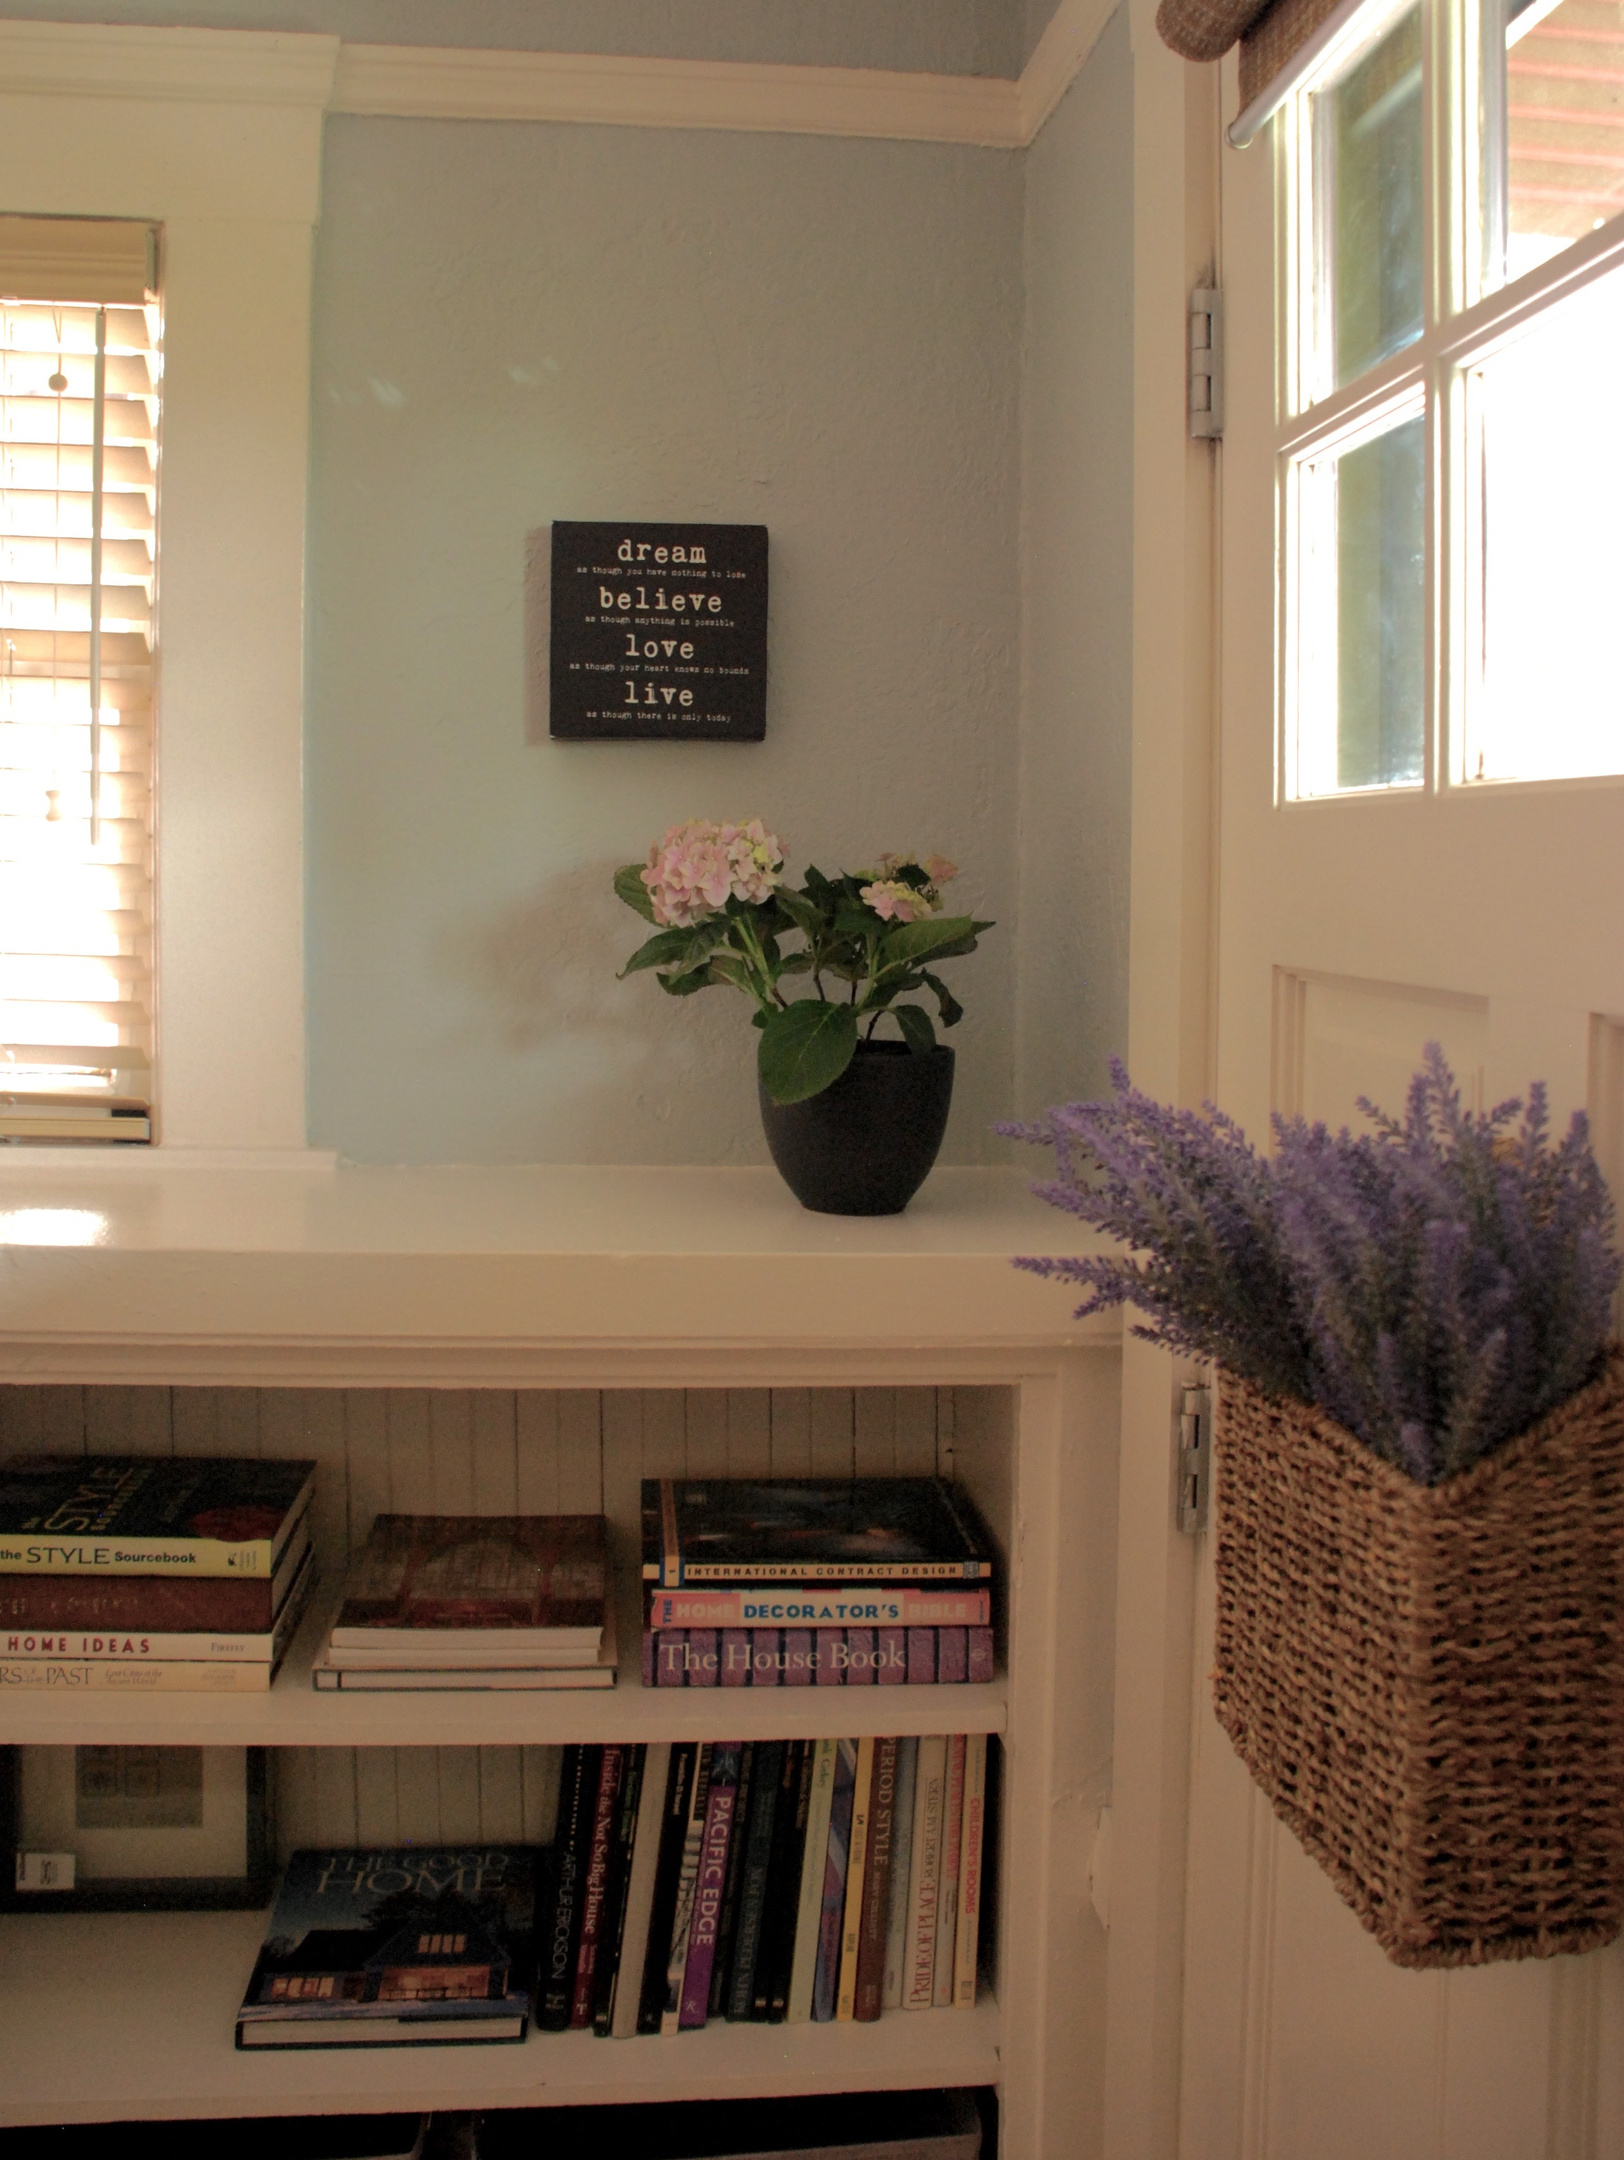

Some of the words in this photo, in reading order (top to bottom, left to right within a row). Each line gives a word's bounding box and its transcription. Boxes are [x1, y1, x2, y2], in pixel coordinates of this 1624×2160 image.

[617, 539, 707, 563] dream
[593, 566, 622, 575] though
[671, 569, 707, 578] nothing
[712, 570, 721, 578] to
[726, 571, 746, 579] lose
[599, 586, 722, 613] believe
[601, 615, 630, 624] though
[635, 616, 675, 626] anything
[695, 619, 734, 627] possible
[626, 634, 694, 659] love
[585, 662, 615, 671] though
[620, 664, 639, 672] your
[644, 664, 669, 672] heart
[674, 665, 699, 673] knows
[719, 667, 749, 675] bounds
[625, 682, 693, 706] live
[602, 711, 632, 719] though
[637, 712, 662, 720] there
[682, 713, 701, 722] only
[707, 713, 731, 722] today
[0, 1550, 21, 1560] the
[27, 1547, 110, 1564] STYLE
[115, 1551, 196, 1563] Sourcebook
[687, 1567, 808, 1576] INTERNATIONAL
[816, 1566, 894, 1576] CONTRACT
[902, 1566, 957, 1575] DESIGN
[662, 1599, 673, 1623] THE
[676, 1603, 735, 1619] HOME
[744, 1603, 899, 1619] DECORATOR'S
[908, 1603, 967, 1619] BIBLE
[8, 1637, 67, 1651] HOME
[83, 1637, 150, 1653] IDEAS
[660, 1643, 718, 1671] The
[727, 1643, 821, 1670] House
[830, 1639, 907, 1669] Book
[46, 1667, 93, 1685] PAST
[600, 1748, 618, 1795] Inside
[599, 1796, 609, 1814] the
[595, 1816, 611, 1840] Not
[705, 1796, 731, 1879] PACIFIC
[874, 1810, 890, 1866] STYLE
[968, 1798, 980, 1866] CHILDREN'S
[593, 1844, 608, 1862] So
[316, 1868, 507, 1894] HOME
[559, 1852, 576, 1905] ARTHUR
[586, 1863, 605, 1887] Big
[964, 1869, 977, 1914] ROOMS
[584, 1886, 604, 1934] House
[696, 1887, 719, 1945] EDGE
[917, 1880, 936, 1929] PLACE
[551, 1907, 572, 1979] ERICKSON
[916, 1932, 932, 1954] OF
[909, 1955, 931, 2003] PRIDE
[733, 1969, 749, 2015] KOHN
